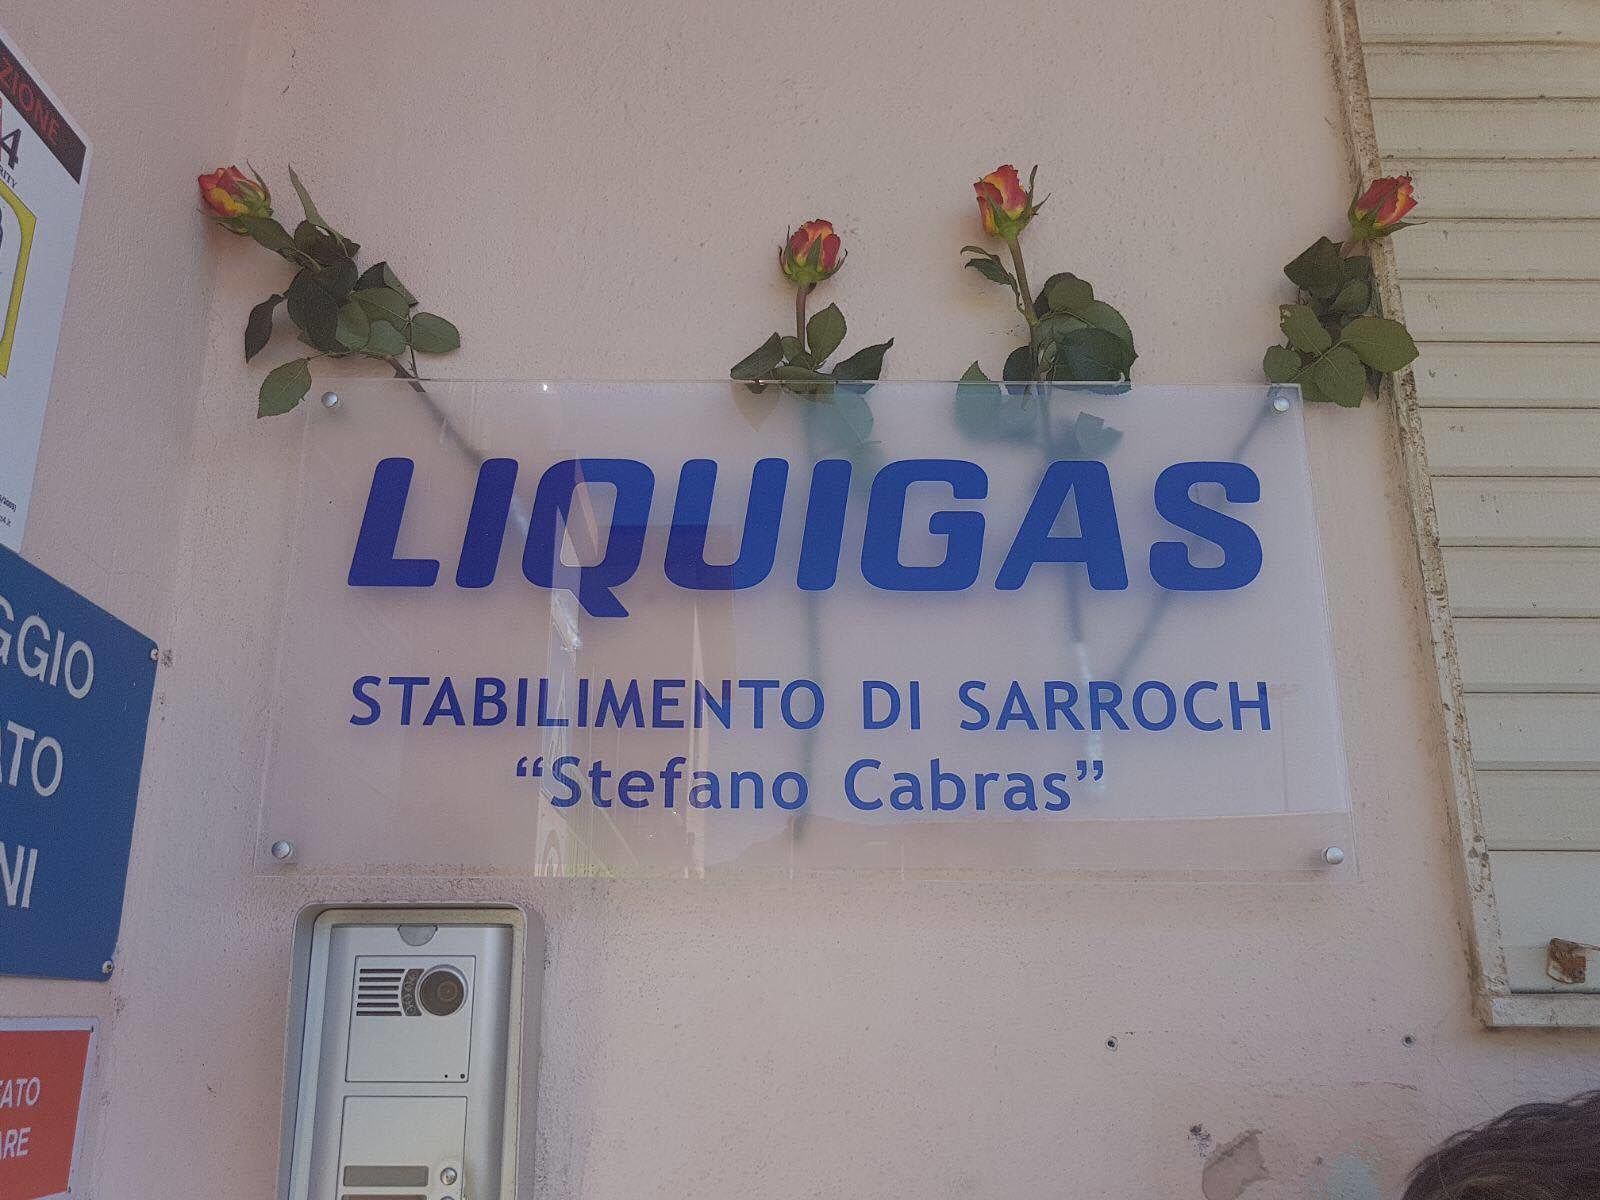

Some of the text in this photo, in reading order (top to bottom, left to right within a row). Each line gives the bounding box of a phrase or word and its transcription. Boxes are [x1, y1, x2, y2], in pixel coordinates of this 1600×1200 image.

[347, 457, 1265, 619] LIQUIGAS
[349, 675, 1273, 734] STABILIMENTO DI SARROCH
[0, 720, 63, 797] TO
[515, 755, 1106, 813] “Stefano Cabras”
[0, 1076, 41, 1108] ATO
[0, 1127, 32, 1159] RE
